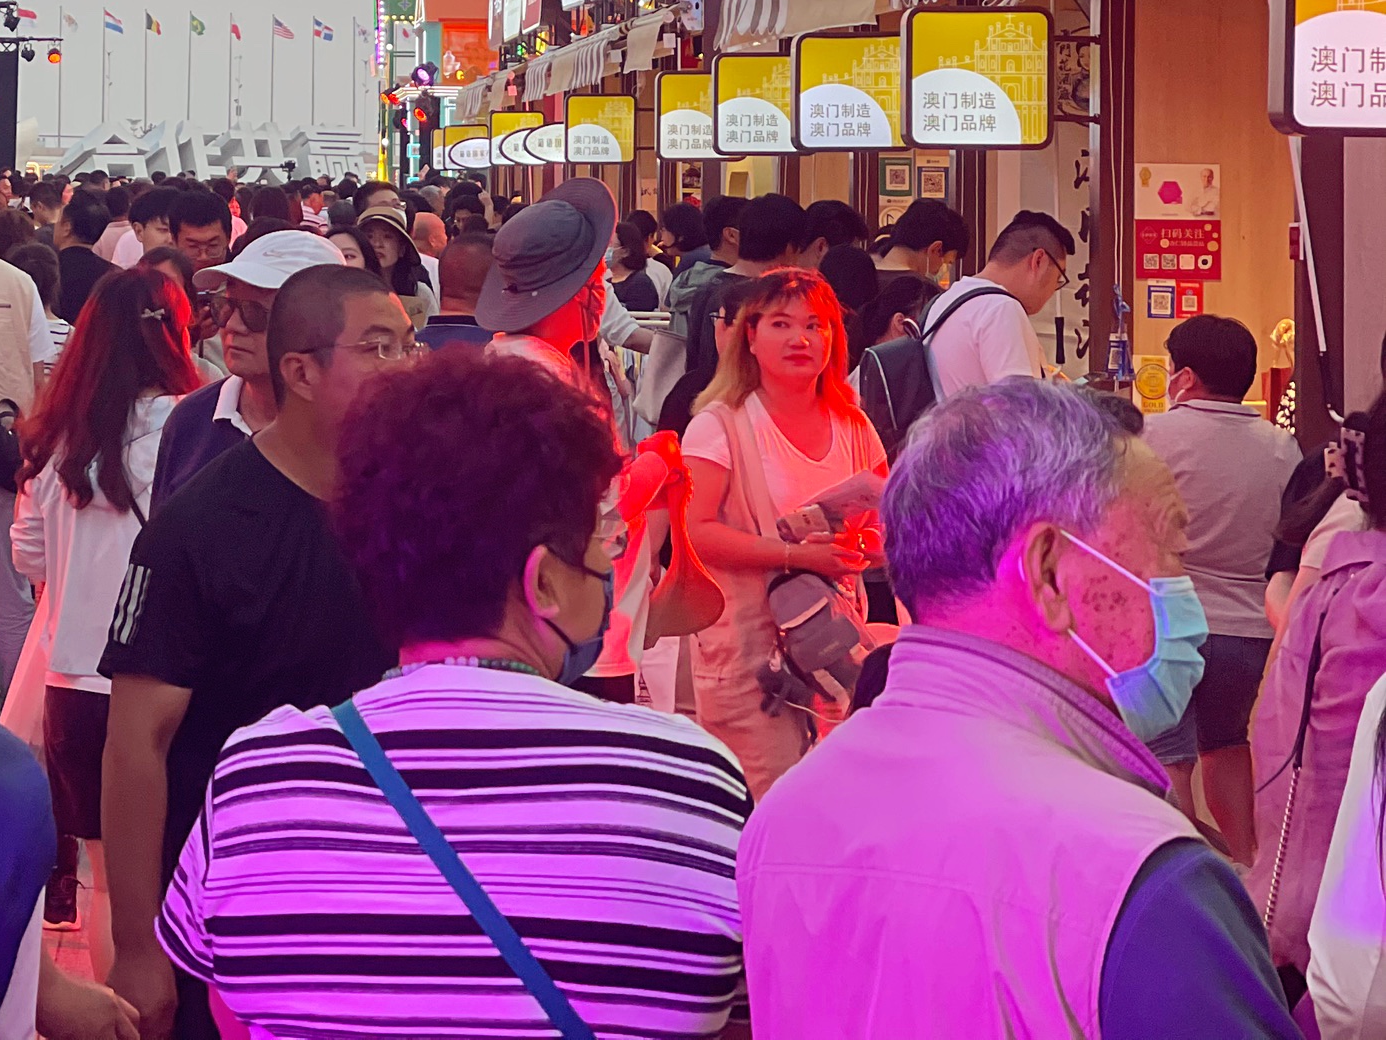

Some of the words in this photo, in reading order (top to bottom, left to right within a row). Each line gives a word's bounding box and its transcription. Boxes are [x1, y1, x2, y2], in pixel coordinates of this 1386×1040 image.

[1311, 45, 1386, 74] 澳门制
[922, 91, 997, 110] 澳门制造
[1310, 80, 1386, 108] 澳门品
[810, 103, 871, 119] 澳门制造
[725, 113, 779, 128] 澳门制造
[922, 114, 997, 132] 澳门品牌
[667, 124, 712, 136] 澳门制造
[725, 129, 779, 144] 澳门品牌
[810, 121, 871, 138] 澳门品牌
[573, 135, 609, 145] 澳门制造
[667, 138, 712, 150] 澳门品牌
[573, 146, 609, 156] 澳门品牌
[1160, 228, 1205, 239] 扫码关注
